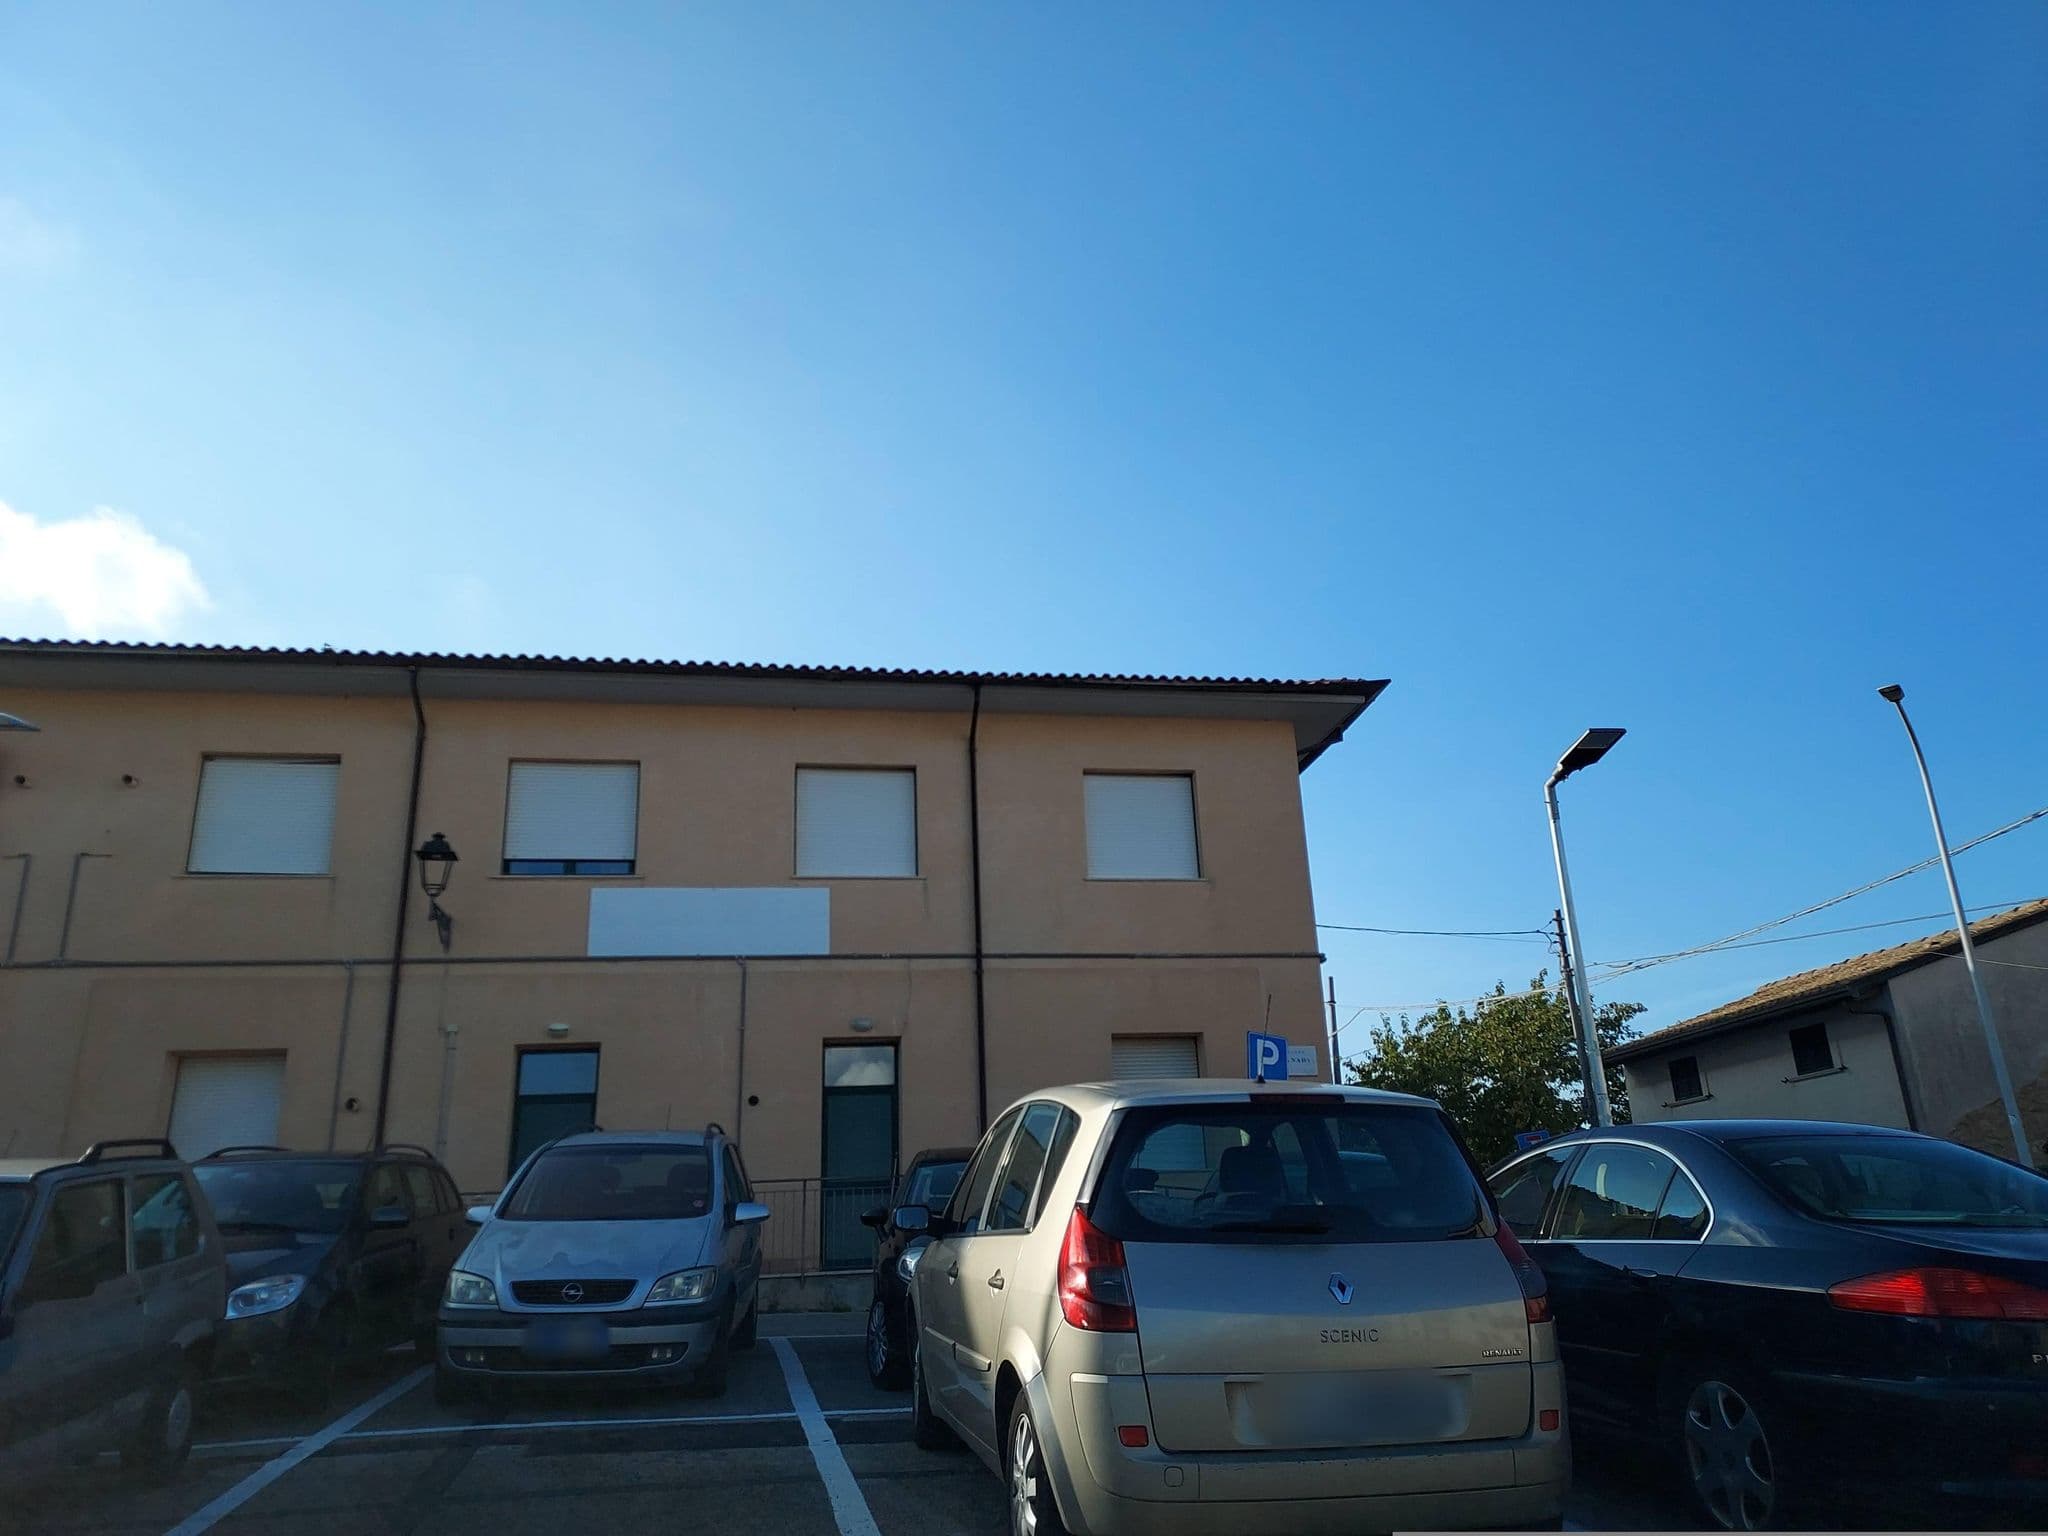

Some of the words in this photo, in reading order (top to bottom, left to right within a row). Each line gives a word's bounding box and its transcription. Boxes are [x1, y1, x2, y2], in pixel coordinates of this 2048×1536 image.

[1257, 1038, 1280, 1078] P
[1319, 1329, 1379, 1343] SCENIC
[1481, 1347, 1524, 1358] RENAULT
[2032, 1354, 2048, 1364] P
